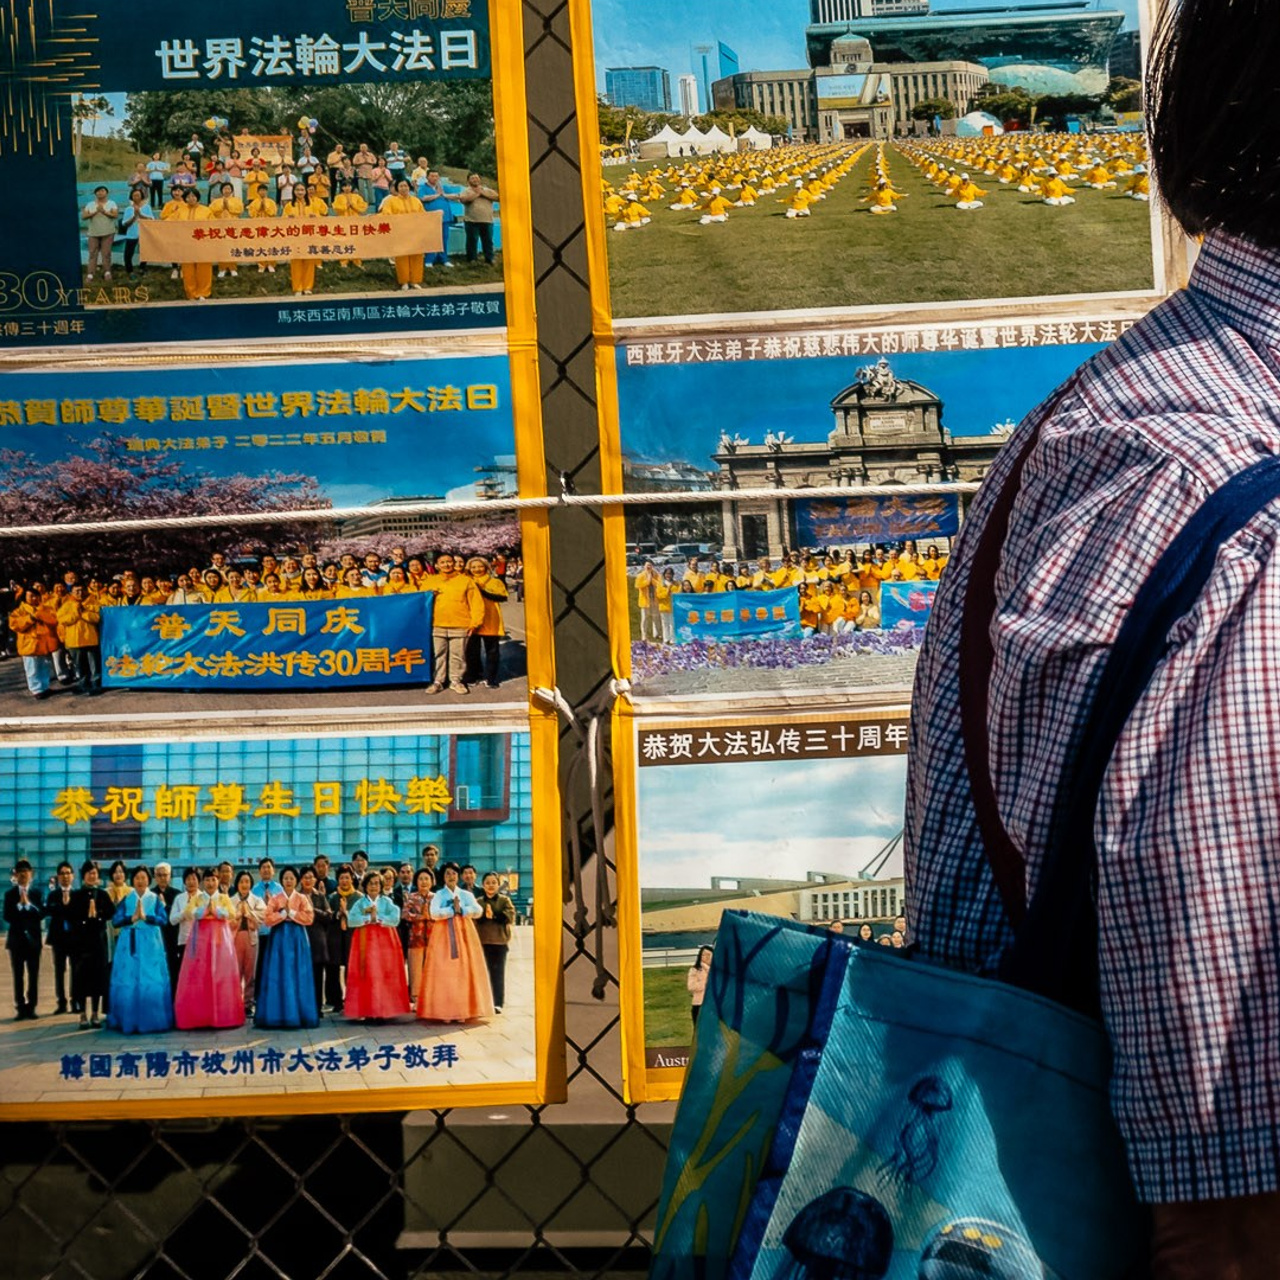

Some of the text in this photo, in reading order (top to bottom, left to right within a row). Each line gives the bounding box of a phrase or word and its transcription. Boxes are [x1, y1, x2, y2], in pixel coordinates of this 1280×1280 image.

[154, 28, 480, 80] 世界法輪大法日
[55, 285, 149, 306] YEARS
[0, 320, 86, 336] 傳三十週年
[151, 606, 367, 642] 普天同庆
[105, 647, 427, 680] 法轮大法洪传30周年
[642, 723, 908, 761] 恭贺大法弘传三十周年
[50, 775, 454, 825] 恭祝師尊生日快樂
